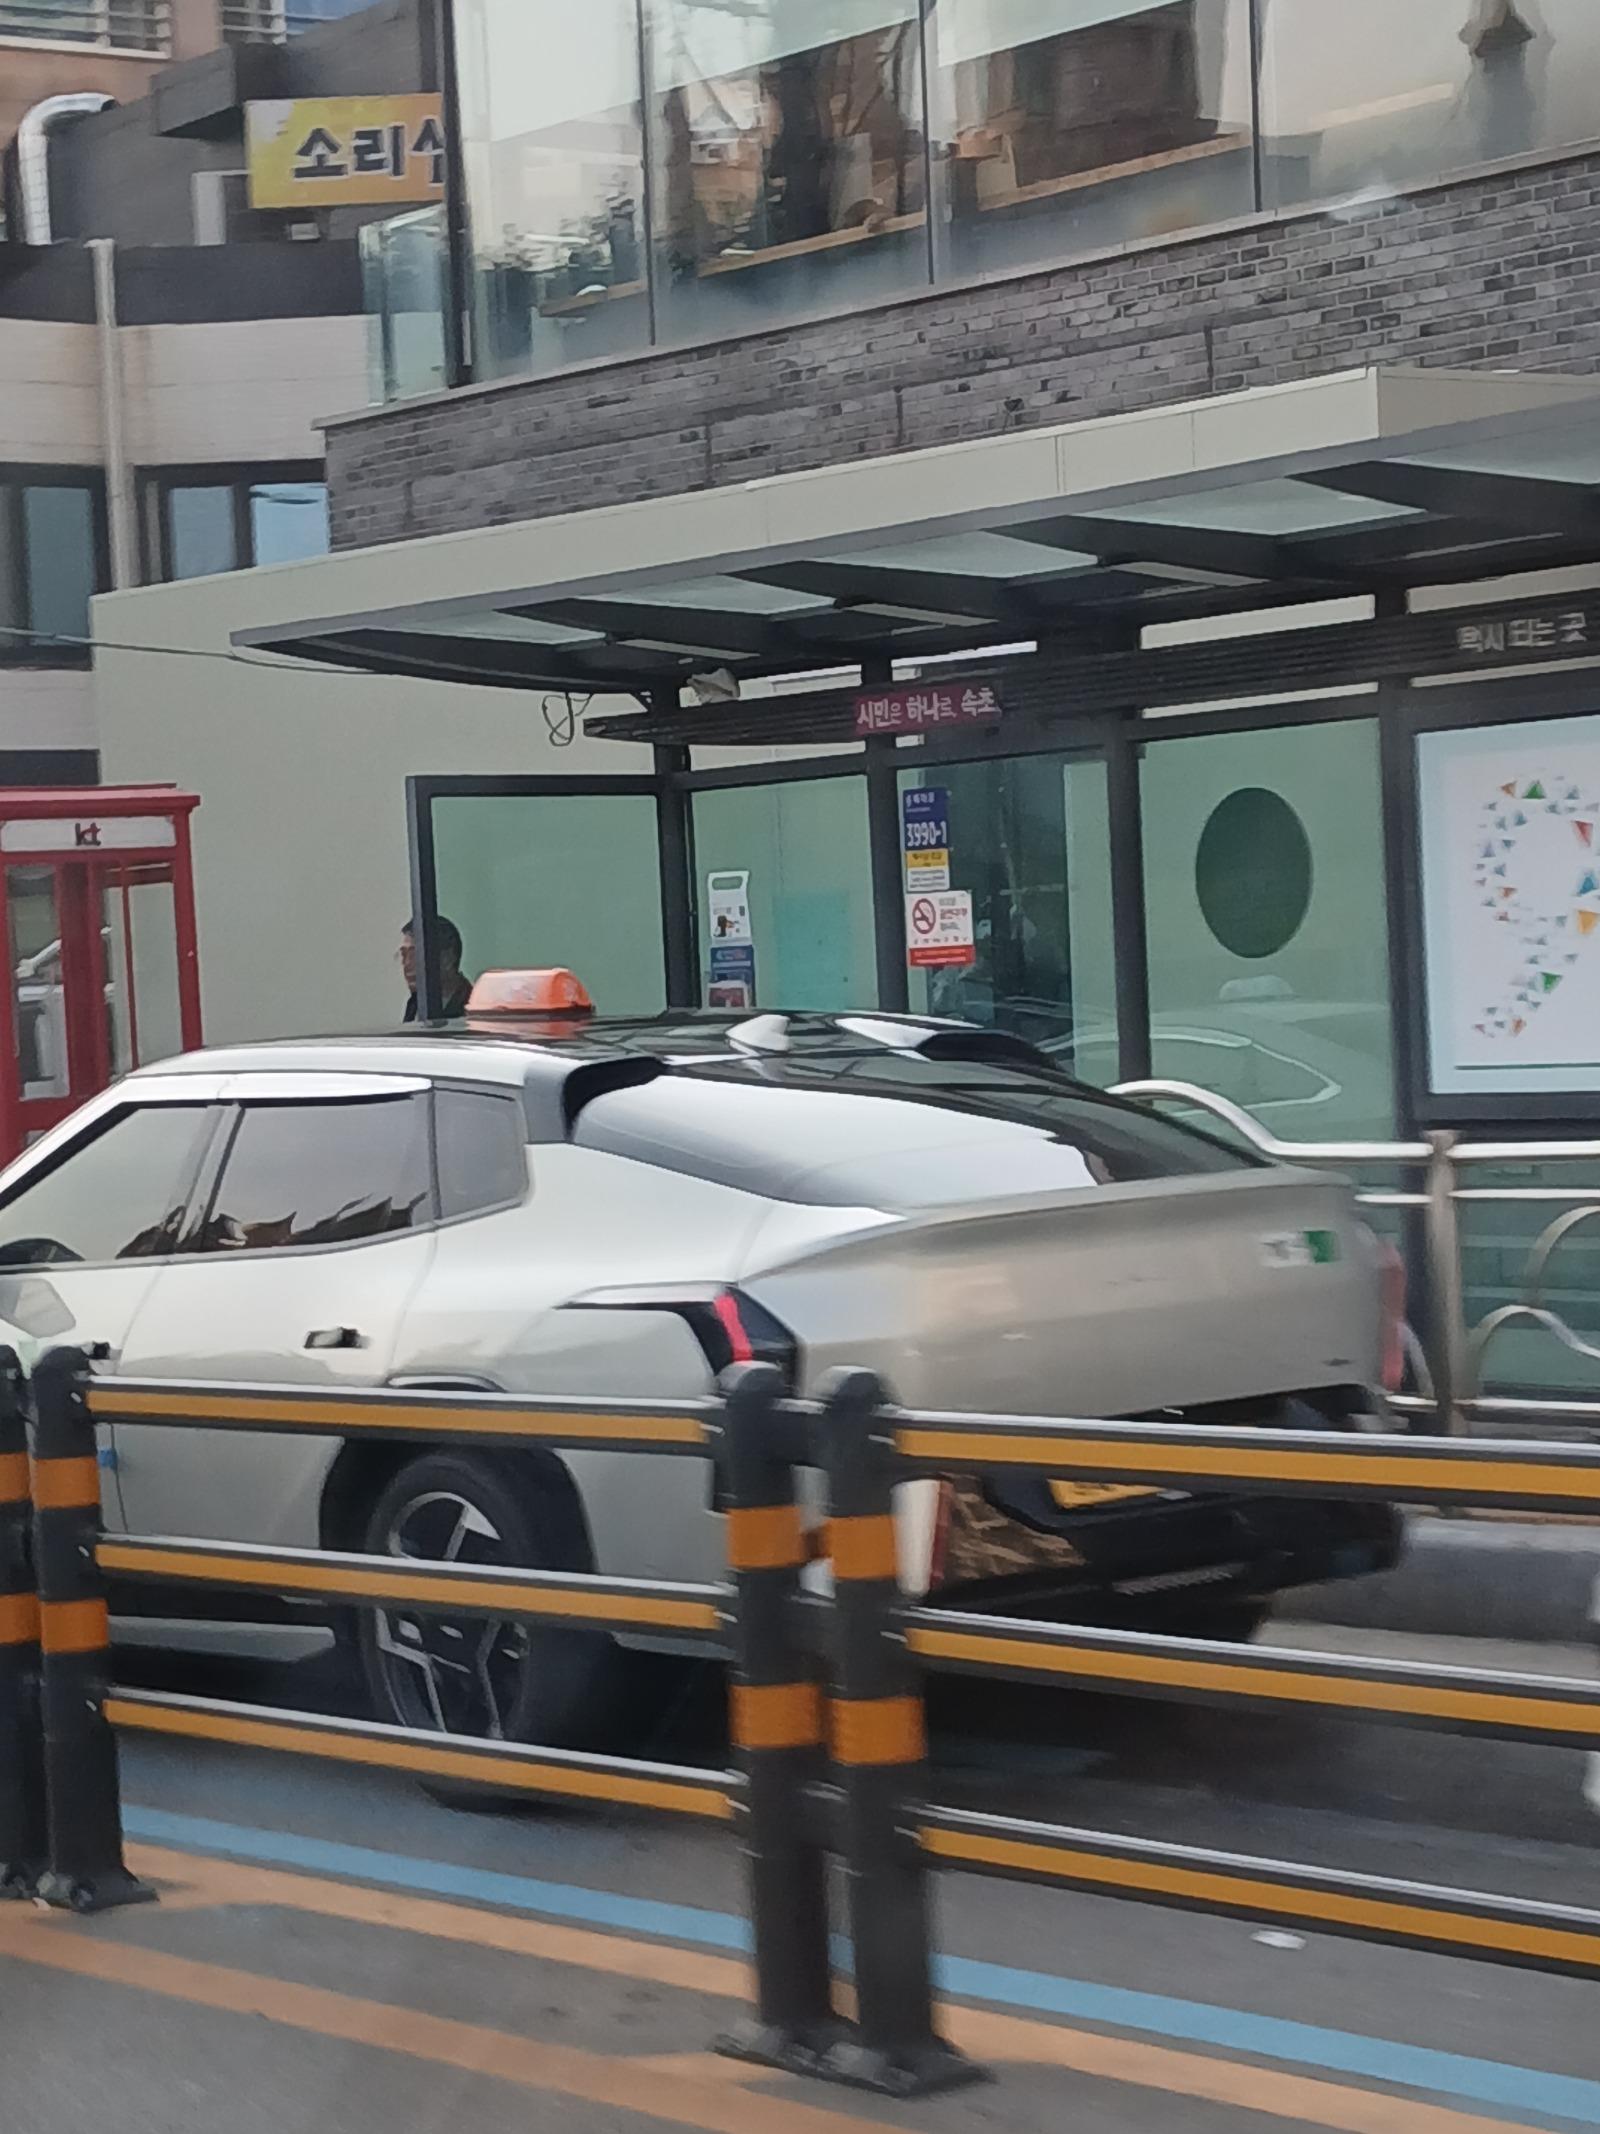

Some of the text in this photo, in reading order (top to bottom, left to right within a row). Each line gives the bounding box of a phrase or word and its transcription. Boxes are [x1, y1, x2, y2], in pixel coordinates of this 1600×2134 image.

[857, 698, 903, 729] 시민은
[75, 822, 102, 846] kt
[906, 819, 947, 847] 3990-1
